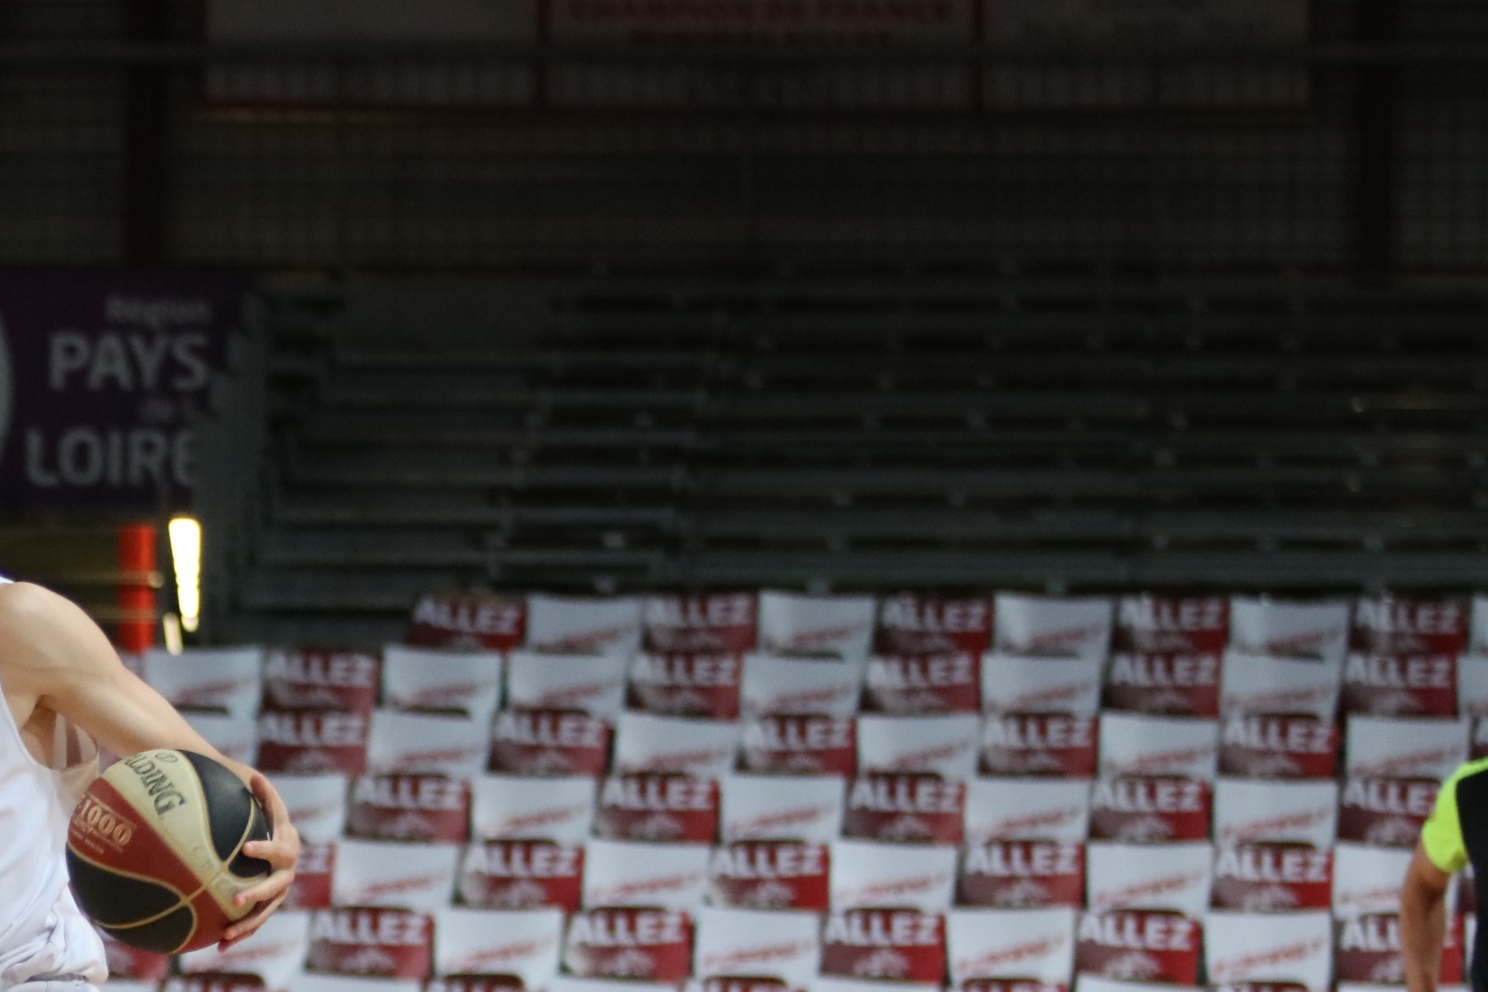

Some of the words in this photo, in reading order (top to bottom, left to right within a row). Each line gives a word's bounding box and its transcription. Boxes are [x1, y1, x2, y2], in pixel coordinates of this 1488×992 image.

[49, 330, 210, 392] PAYS
[493, 713, 603, 747] ALLEZ
[980, 715, 1087, 749] ALLEZ
[1221, 714, 1334, 753] ALLEZ
[350, 778, 462, 810] ALLEZ
[595, 778, 711, 811] ALLEZ
[844, 778, 958, 812] ALLEZ
[1090, 778, 1203, 812] ALLEZ
[1338, 779, 1442, 816] ALLE
[82, 799, 132, 847] 1000
[465, 841, 577, 878] ALLEZ
[716, 841, 824, 878] ALLEZ
[967, 839, 1080, 876] ALLEZ
[1214, 841, 1330, 881] ALLEZ
[308, 909, 426, 945] ALLEZ
[569, 908, 684, 945] ALLEZ
[825, 909, 937, 946] ALLEZ
[1077, 909, 1193, 950] ALLEZ
